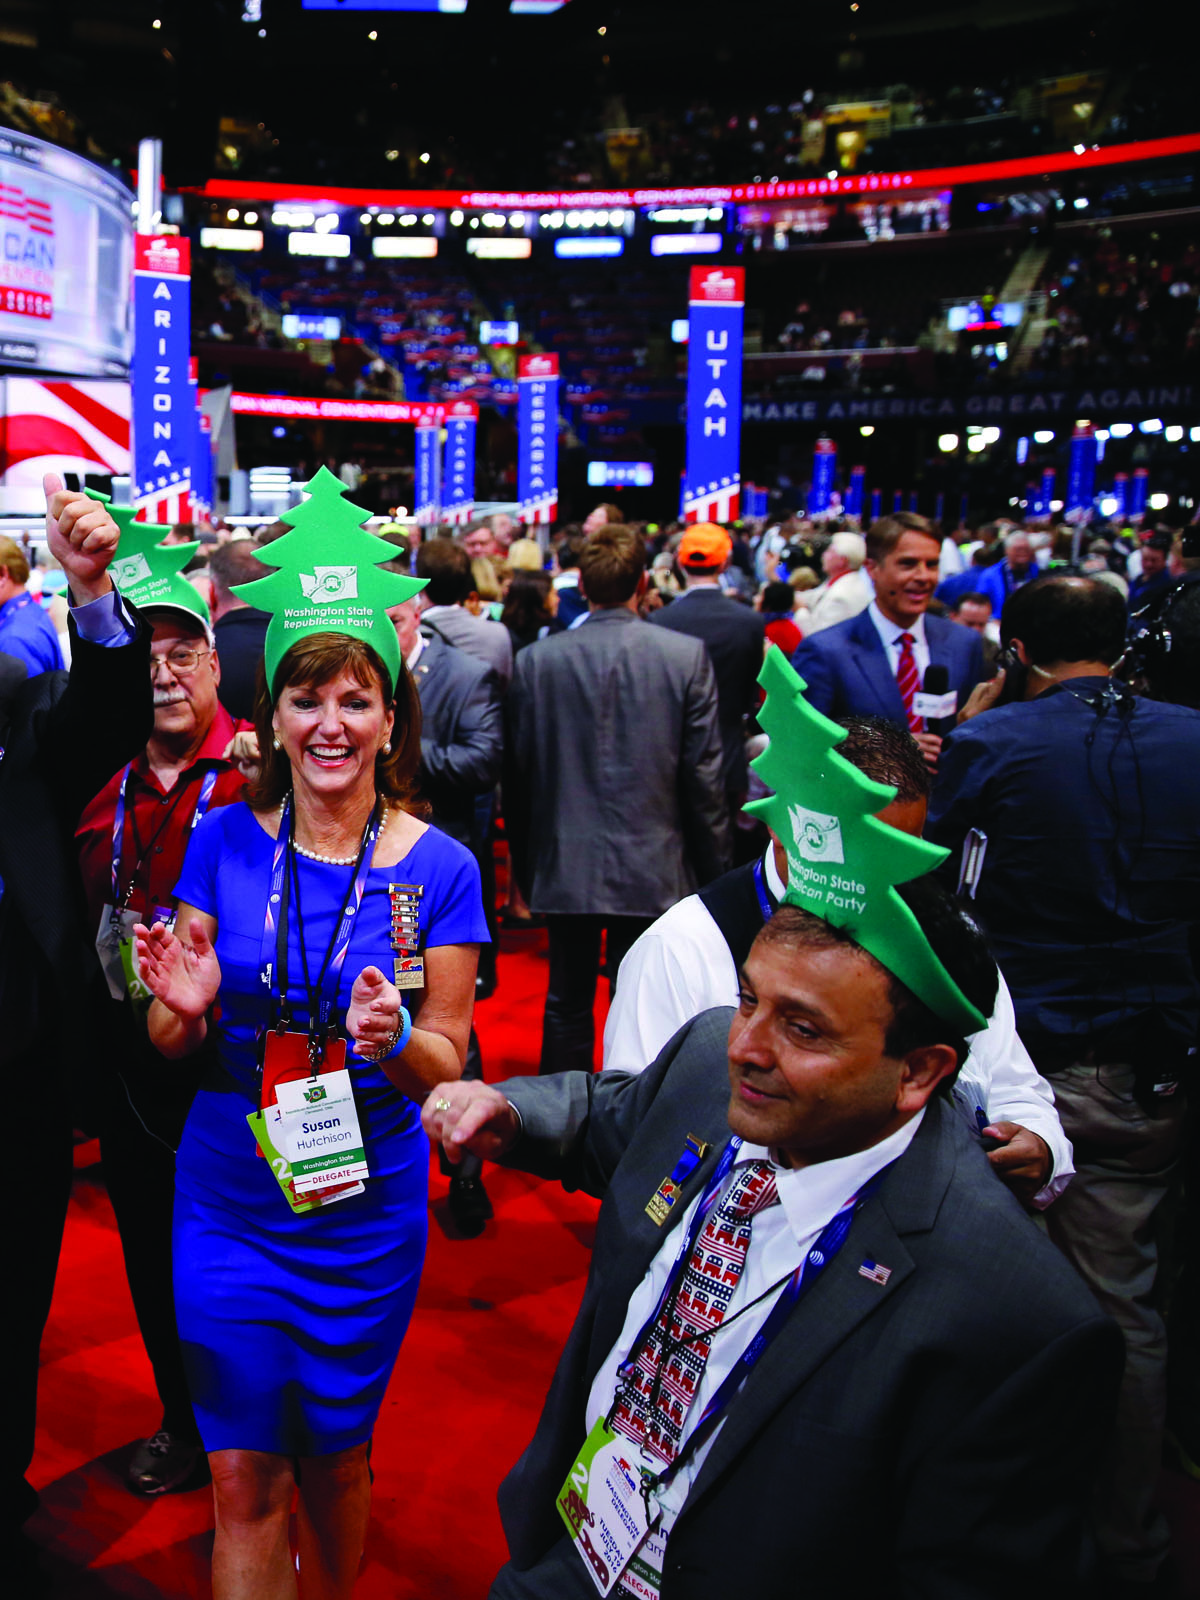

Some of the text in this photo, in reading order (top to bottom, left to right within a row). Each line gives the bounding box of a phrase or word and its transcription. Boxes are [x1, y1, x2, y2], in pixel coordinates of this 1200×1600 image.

[153, 281, 172, 467] ARIZONA
[704, 329, 728, 437] UTAH
[743, 387, 1192, 421] MAKE AMERICA GREAT AGAIN!
[530, 383, 546, 488] NEBRASKA
[452, 420, 467, 498] ALASKA
[148, 578, 168, 590] State
[150, 585, 172, 597] Party
[284, 606, 373, 618] Washington State
[284, 617, 374, 629] Republican Party
[830, 875, 865, 894] State
[826, 891, 866, 914] Party
[302, 1118, 341, 1134] Susan
[297, 1131, 352, 1150] Hutchison
[272, 1158, 293, 1180] 2
[302, 1154, 355, 1171] Washington State
[312, 1169, 351, 1184] DELEGATE
[571, 1462, 589, 1494] 2
[605, 1478, 640, 1536] WASHINGTON
[611, 1498, 637, 1541] DELEGATE
[599, 1518, 624, 1561] TUESDAY
[599, 1532, 621, 1567] JULY 19
[603, 1550, 617, 1574] 2016
[623, 1573, 658, 1600] ELEGATE
